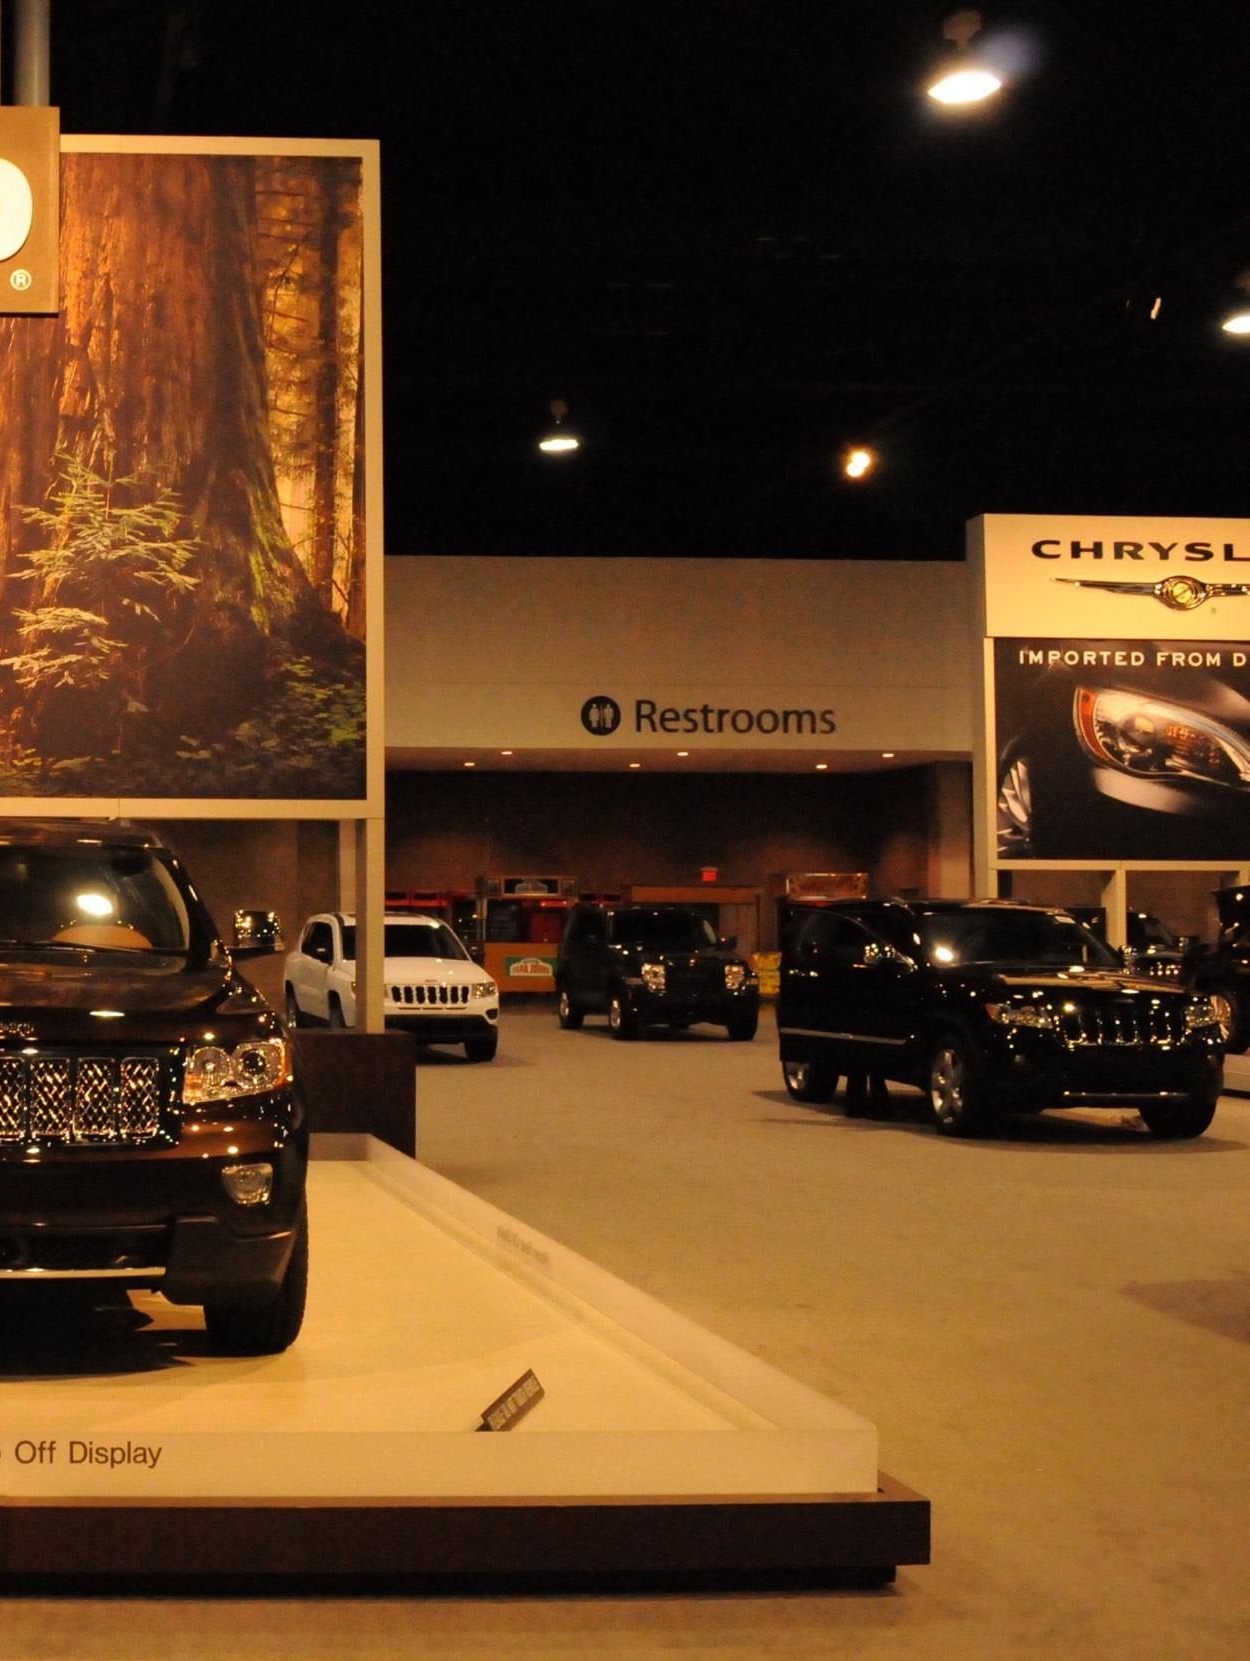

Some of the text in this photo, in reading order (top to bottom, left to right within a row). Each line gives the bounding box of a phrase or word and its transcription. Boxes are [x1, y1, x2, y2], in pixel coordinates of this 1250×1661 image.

[1031, 539, 1250, 561] CHRYSL
[1019, 650, 1145, 667] IMPORTED
[1156, 652, 1221, 667] FROM
[635, 699, 837, 735] Restrooms
[14, 1440, 57, 1464] Off
[69, 1440, 163, 1469] Display
